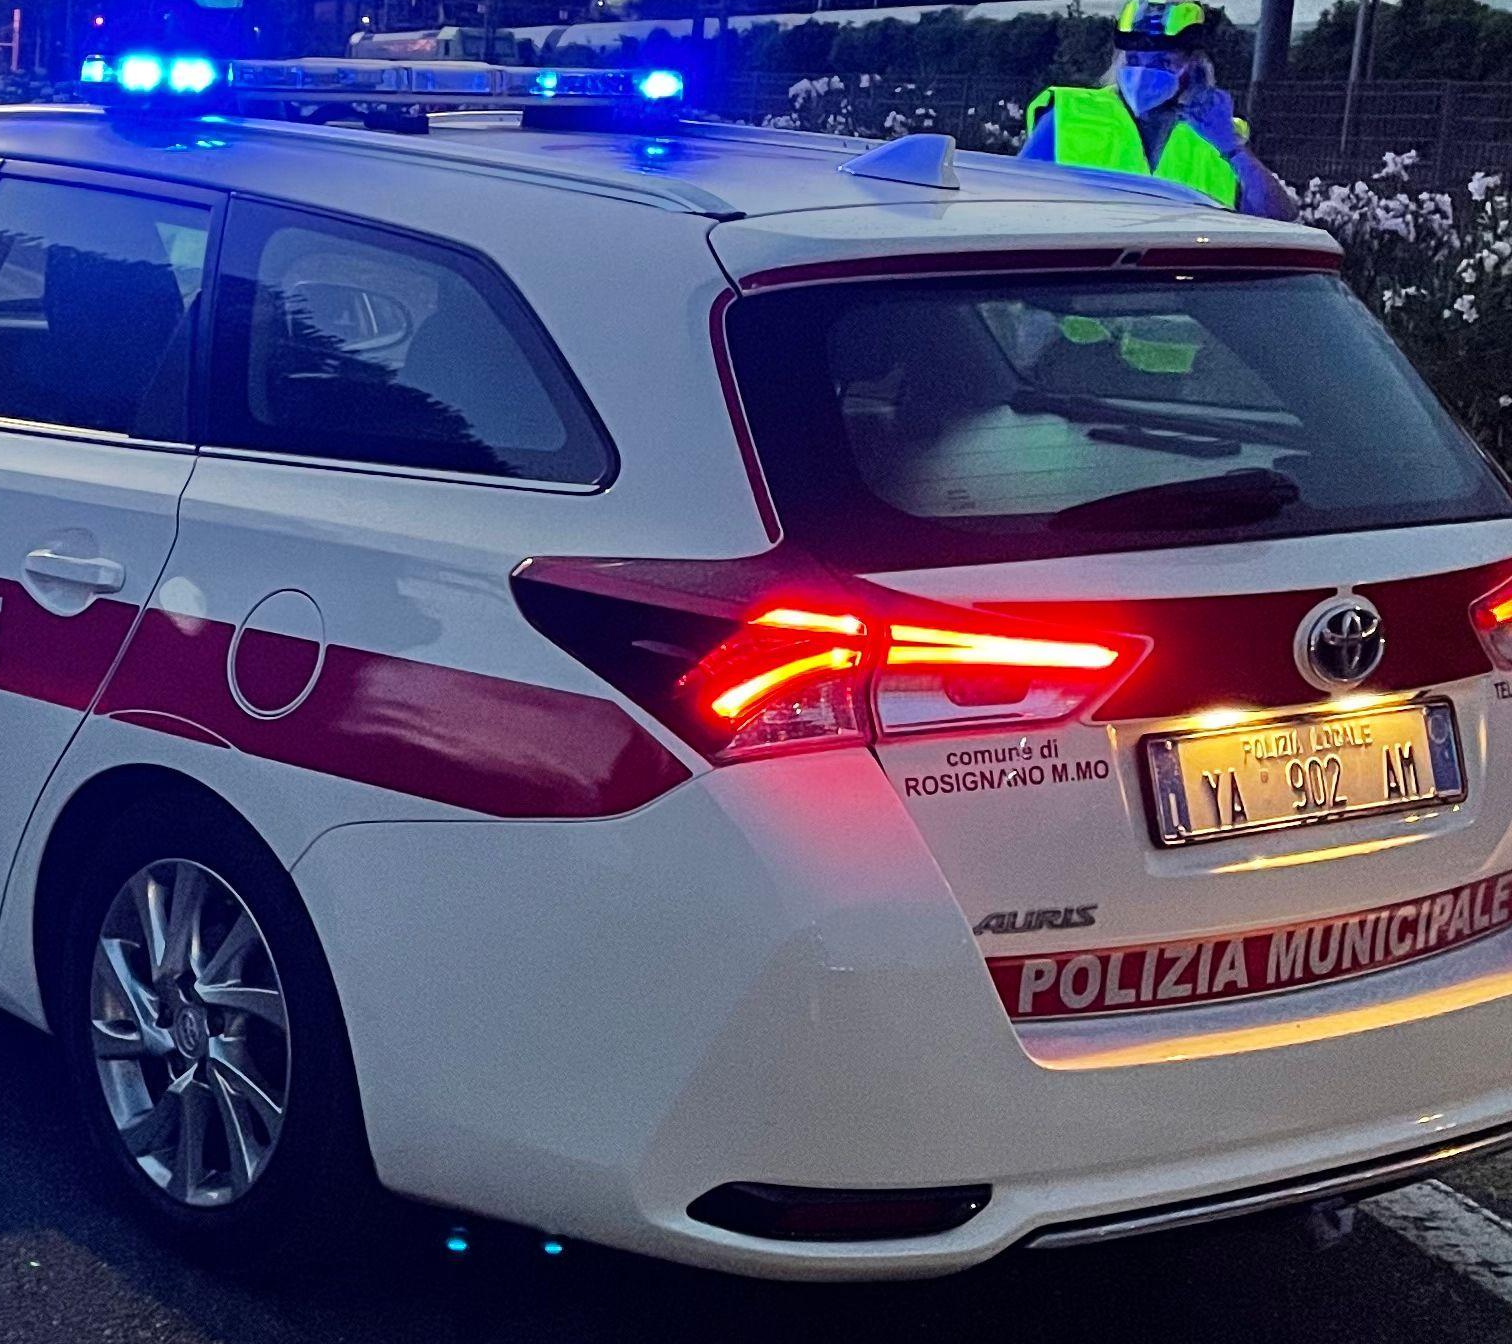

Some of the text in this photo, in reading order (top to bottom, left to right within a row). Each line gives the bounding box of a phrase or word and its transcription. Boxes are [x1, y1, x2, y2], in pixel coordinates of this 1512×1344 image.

[946, 738, 1059, 767] comune di
[1243, 723, 1374, 763] POLIZIA LOCALE
[904, 759, 1109, 797] ROSIGNANO M.MO
[1201, 740, 1421, 828] YA 902 AM
[973, 904, 1099, 936] AURIS
[1018, 874, 1512, 1013] POLIZIA MUNICIPALE
